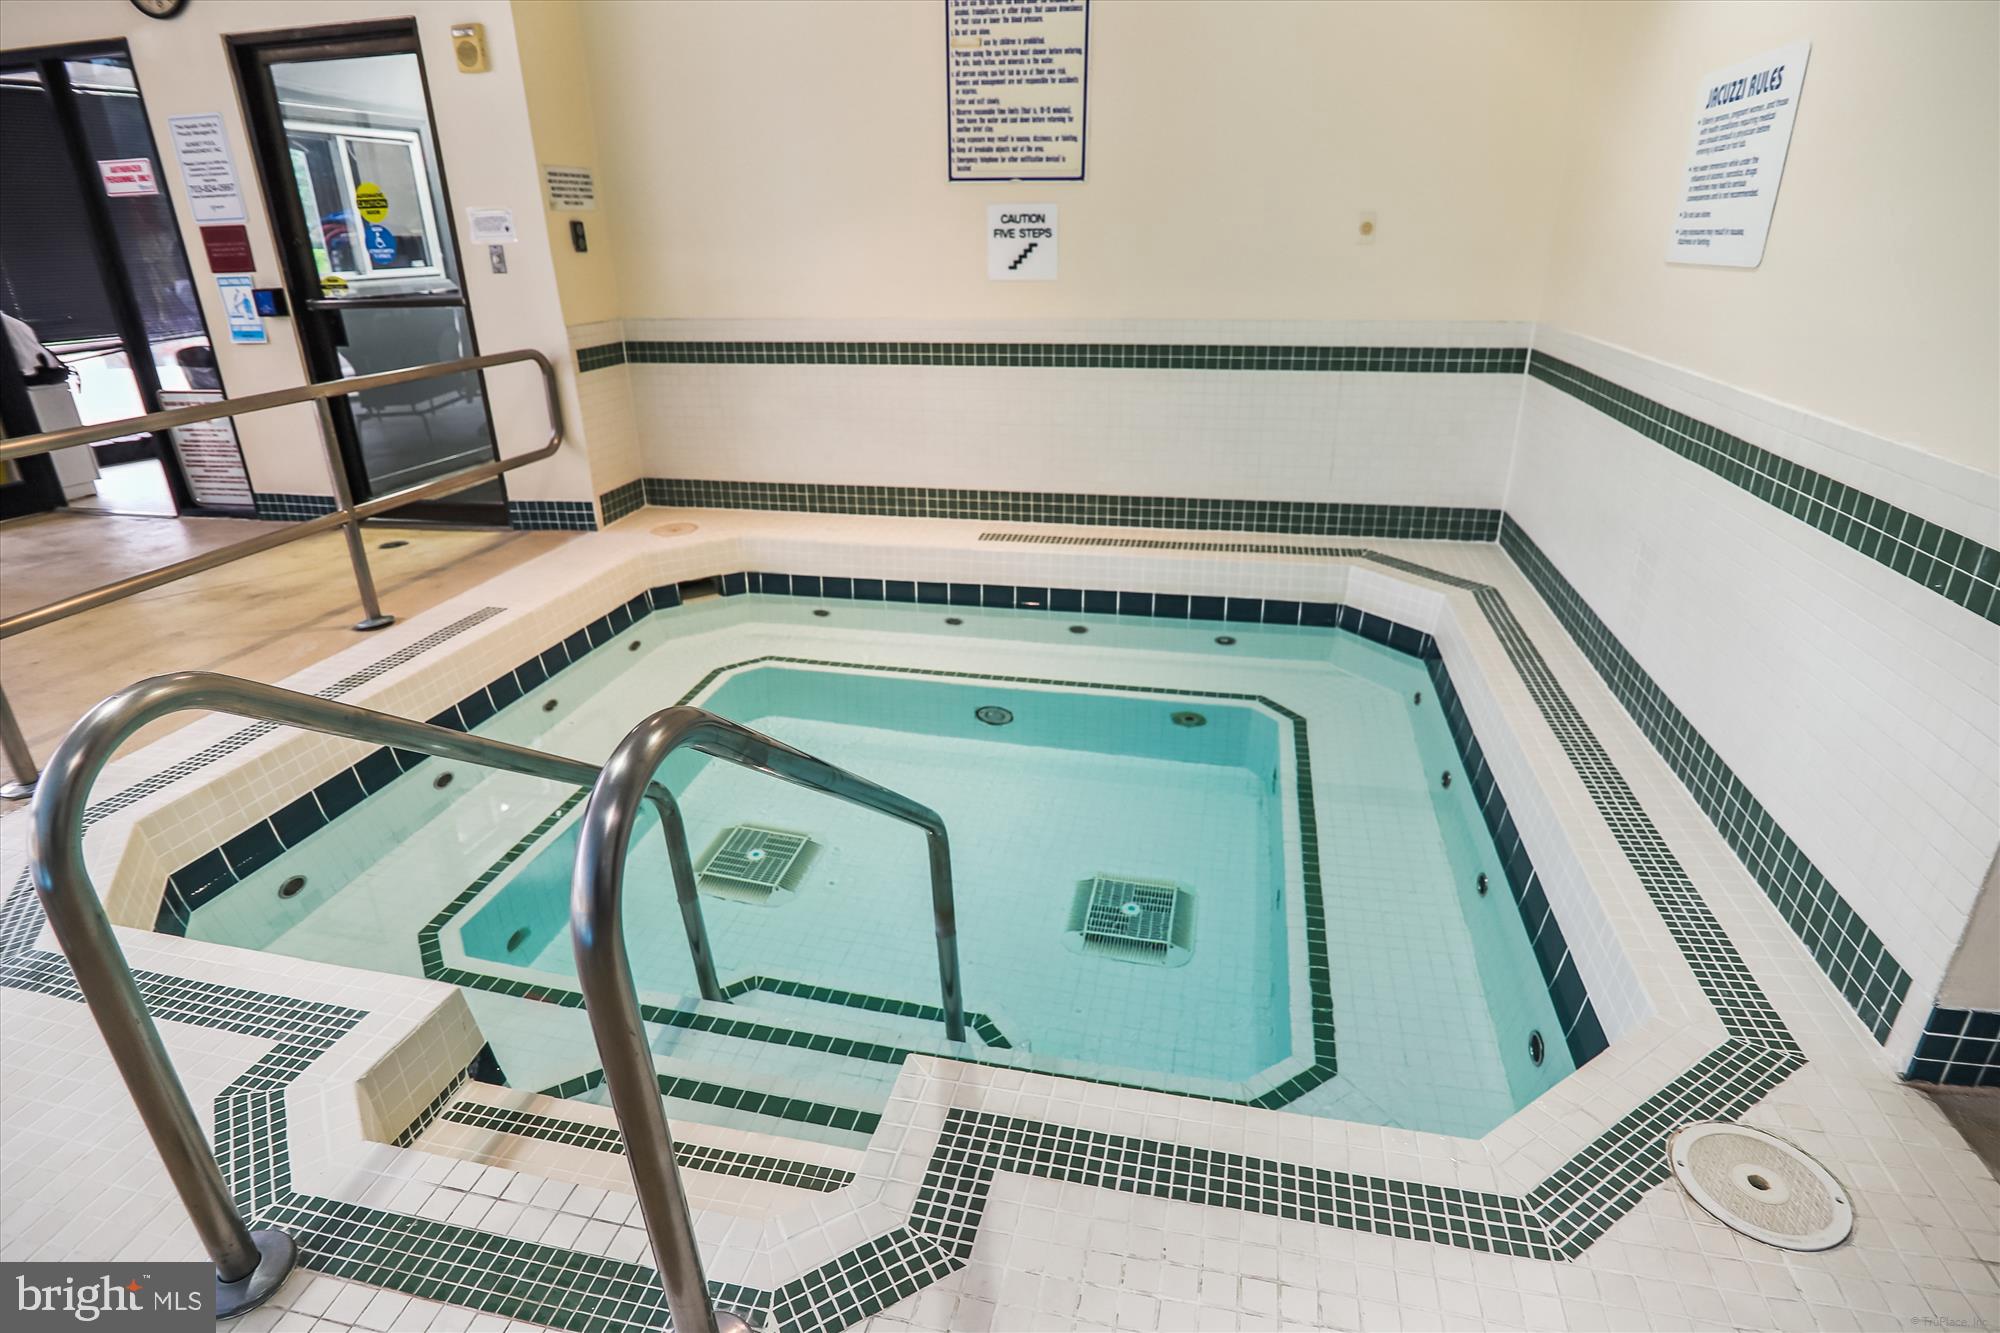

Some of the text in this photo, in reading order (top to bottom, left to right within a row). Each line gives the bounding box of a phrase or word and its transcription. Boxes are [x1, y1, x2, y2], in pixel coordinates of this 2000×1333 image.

[1705, 65, 1784, 109] JACUZZI RULES
[1001, 214, 1046, 224] CAUTION
[994, 228, 1052, 238] FIVE STEPS
